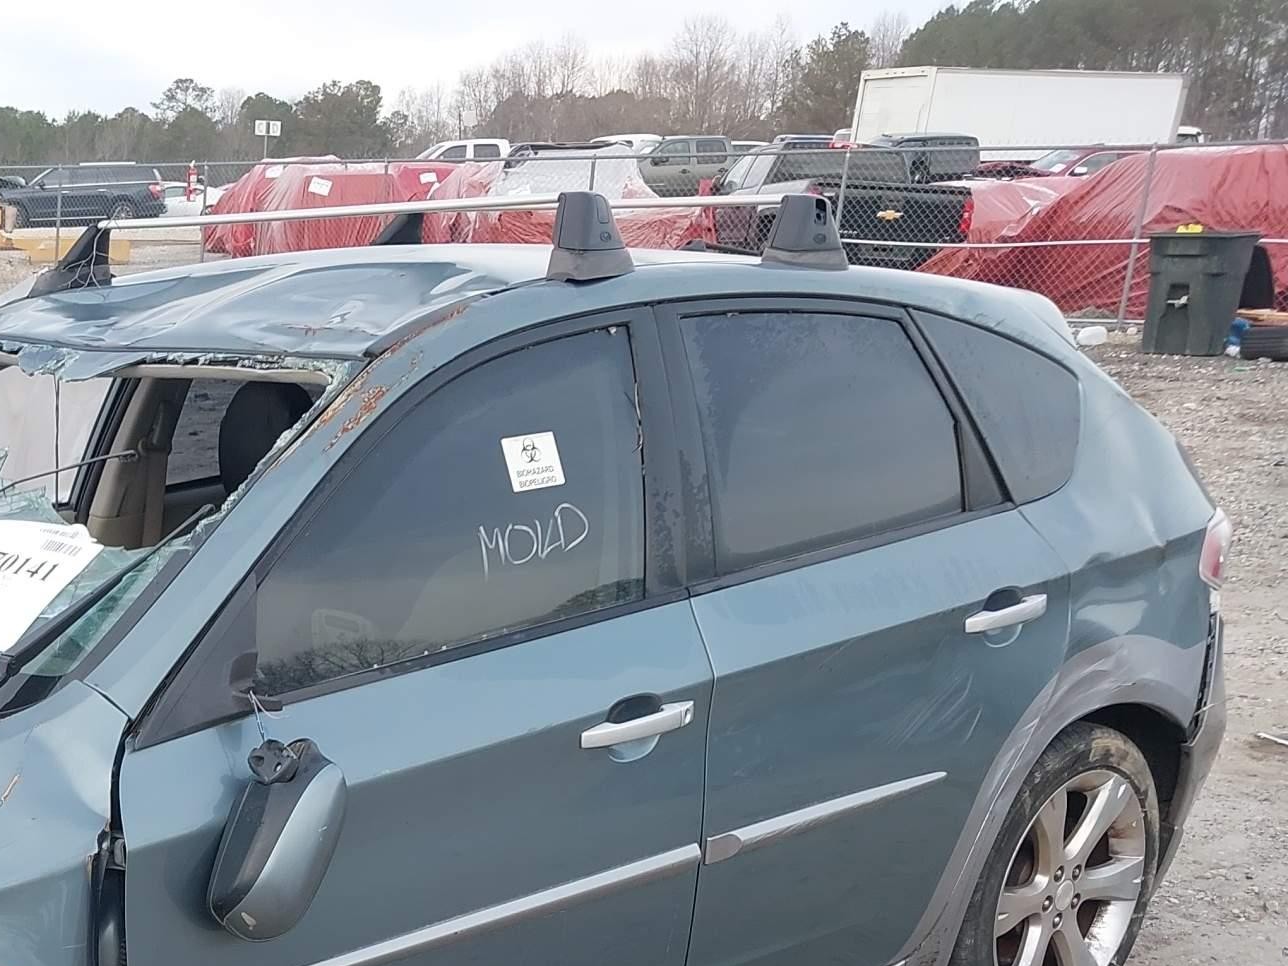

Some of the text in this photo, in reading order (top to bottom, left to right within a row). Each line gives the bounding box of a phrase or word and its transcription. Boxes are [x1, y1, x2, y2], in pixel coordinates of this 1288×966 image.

[516, 465, 554, 478] BIOHAZARD
[519, 476, 557, 488] BIOPELIGRO
[477, 502, 590, 583] MOLD
